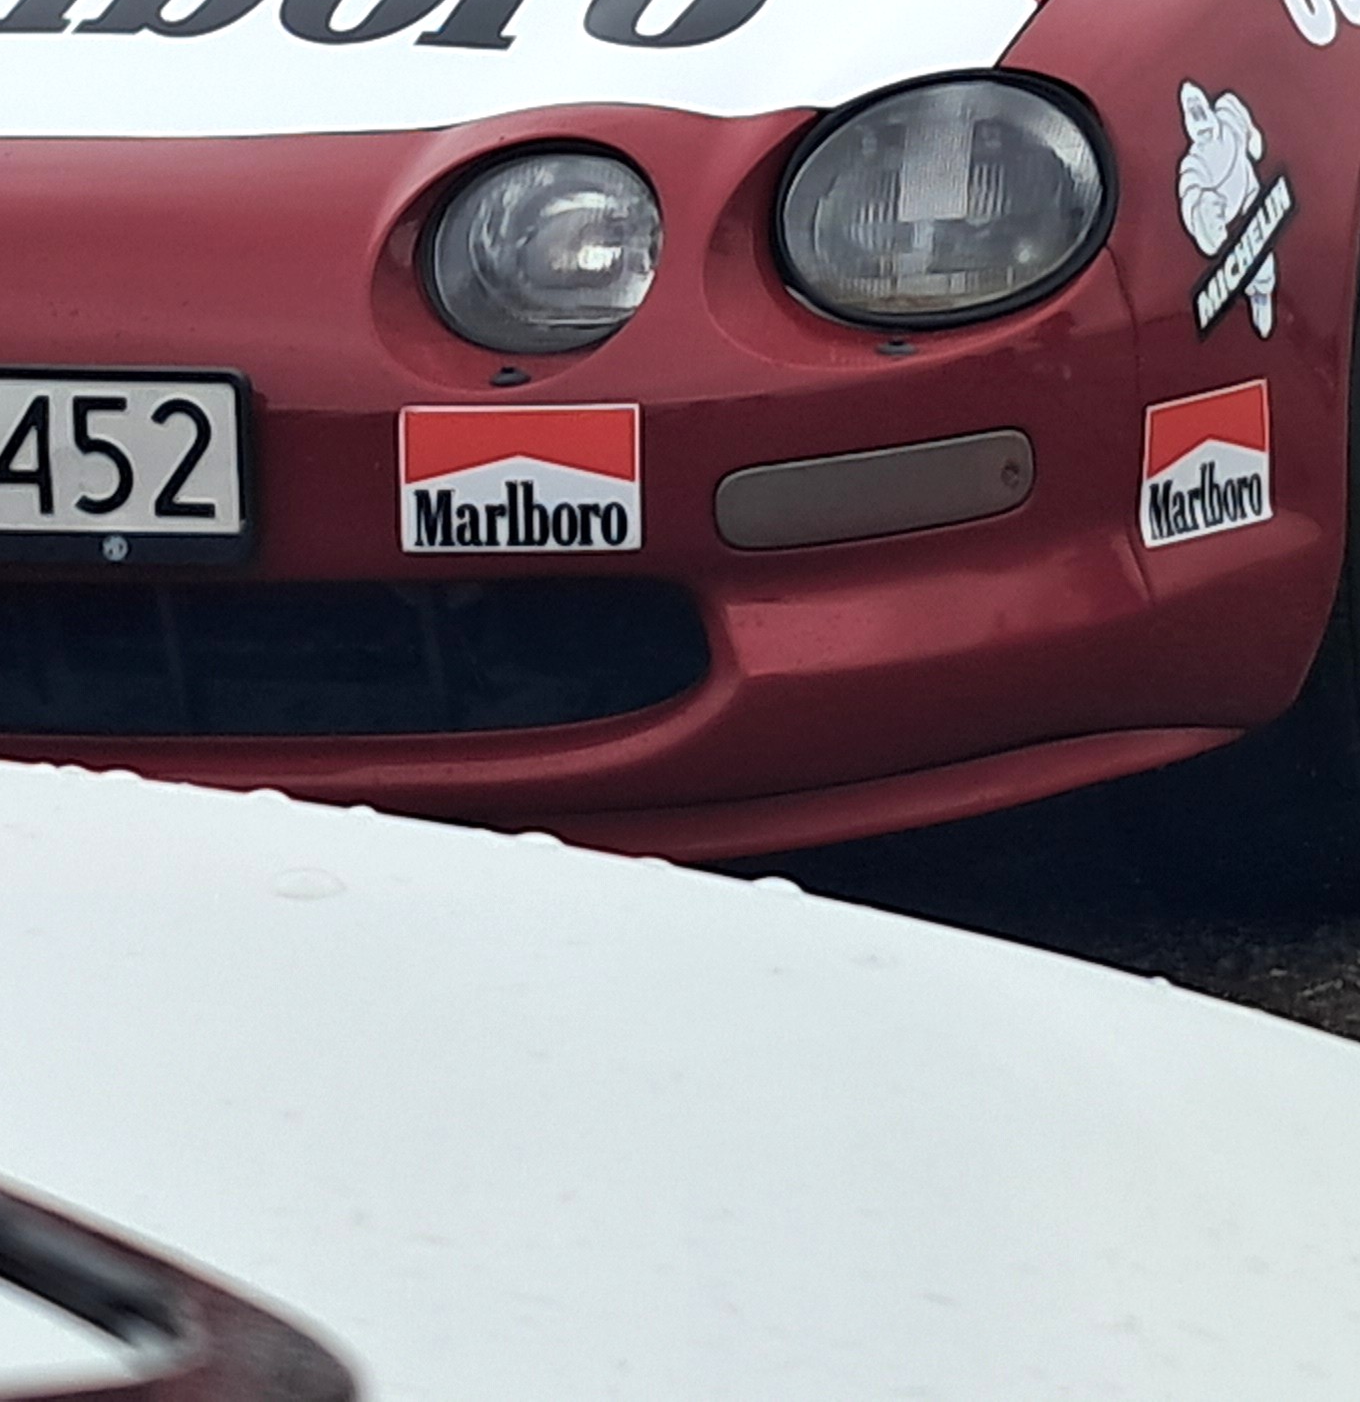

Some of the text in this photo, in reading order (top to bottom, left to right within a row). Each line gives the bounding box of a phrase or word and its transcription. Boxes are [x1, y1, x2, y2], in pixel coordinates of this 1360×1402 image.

[1196, 174, 1293, 331] MICHELIN
[413, 479, 628, 547] Marlboro
[1148, 460, 1263, 541] Marlboro
